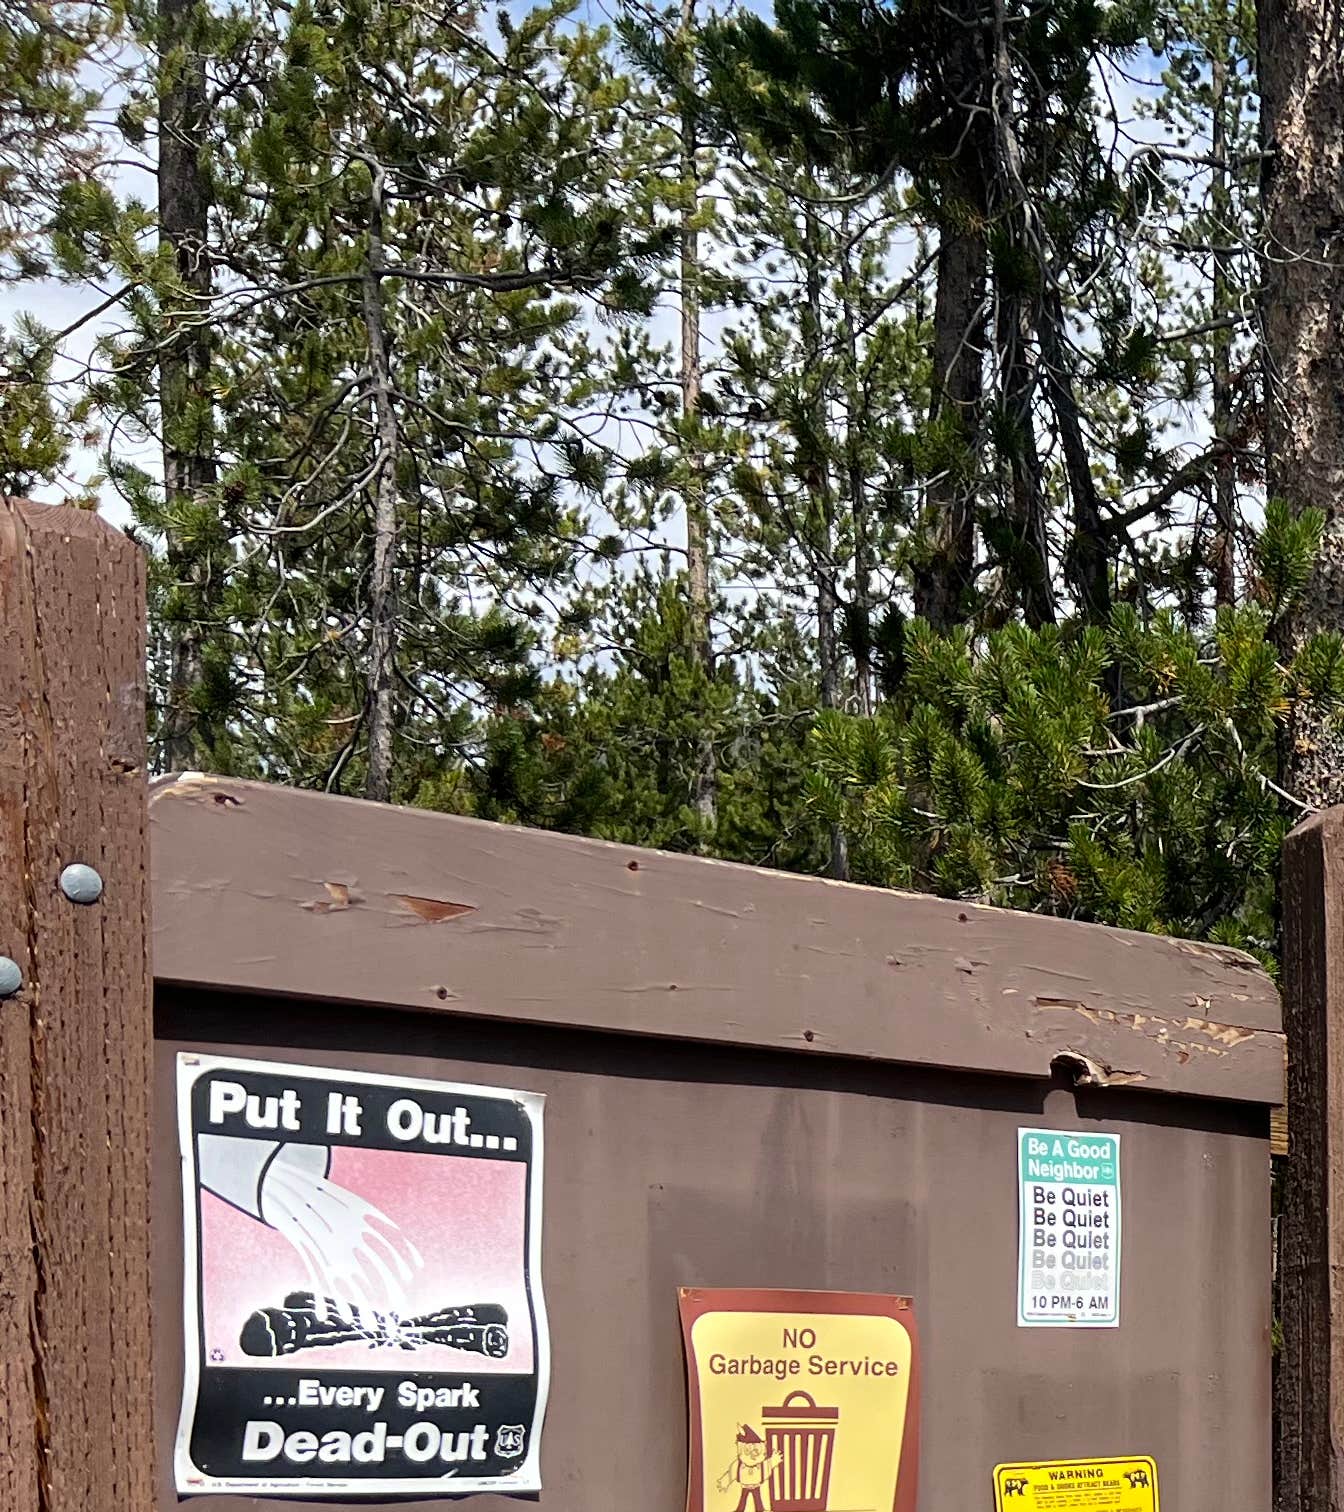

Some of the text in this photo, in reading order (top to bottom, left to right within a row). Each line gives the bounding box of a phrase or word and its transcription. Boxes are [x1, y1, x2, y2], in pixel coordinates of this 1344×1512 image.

[208, 1079, 518, 1151] Put It Out...
[1028, 1138, 1111, 1159] Be A Good
[1028, 1159, 1099, 1181] Neighbor
[1033, 1186, 1109, 1207] Be Quiet
[1032, 1296, 1108, 1309] 10 PM-6 AM
[783, 1328, 816, 1349] NO
[709, 1354, 898, 1379] Garbage Service
[263, 1379, 480, 1412] ...Every Spark
[241, 1420, 489, 1464] Dead-Out
[1048, 1469, 1103, 1480] WARNING
